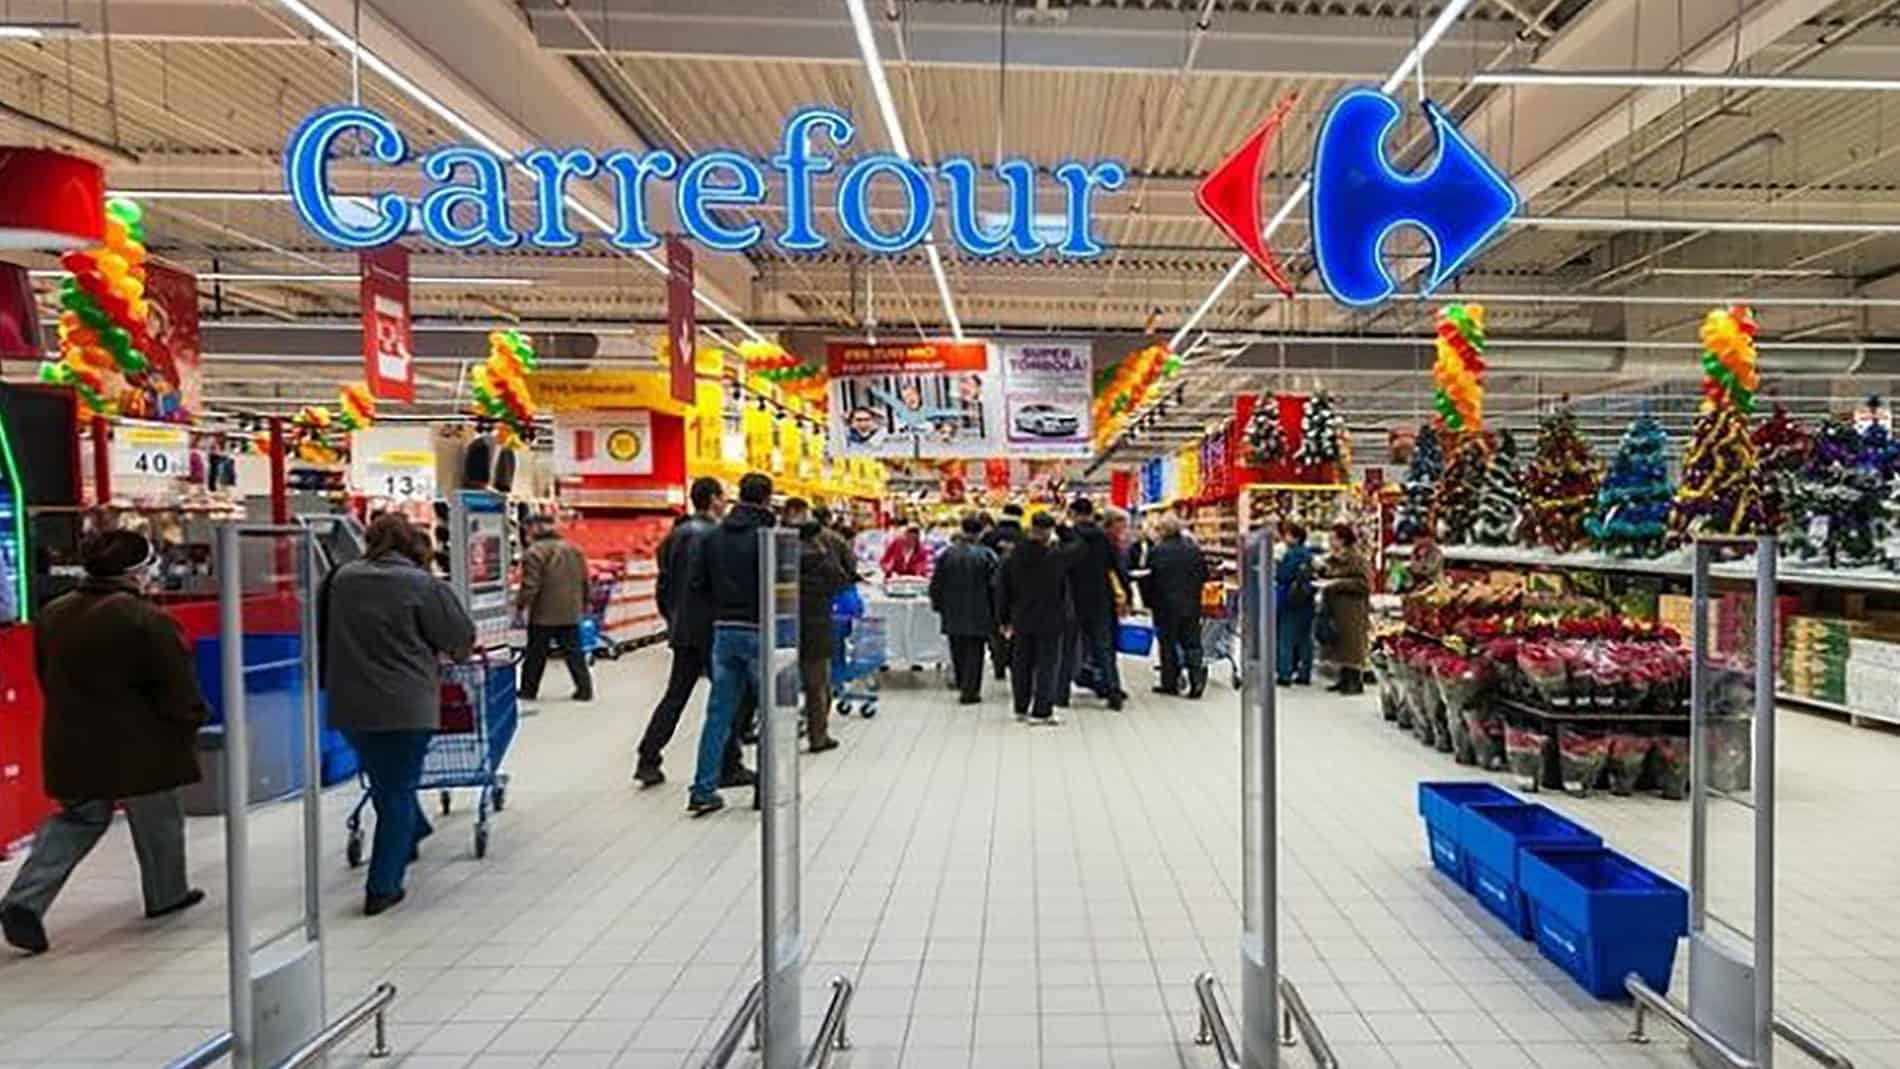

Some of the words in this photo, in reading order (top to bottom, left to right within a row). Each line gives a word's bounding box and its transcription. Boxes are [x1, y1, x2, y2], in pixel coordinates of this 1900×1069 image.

[286, 104, 1127, 257] Carrefour
[136, 452, 167, 473] 40
[386, 476, 415, 495] 13
